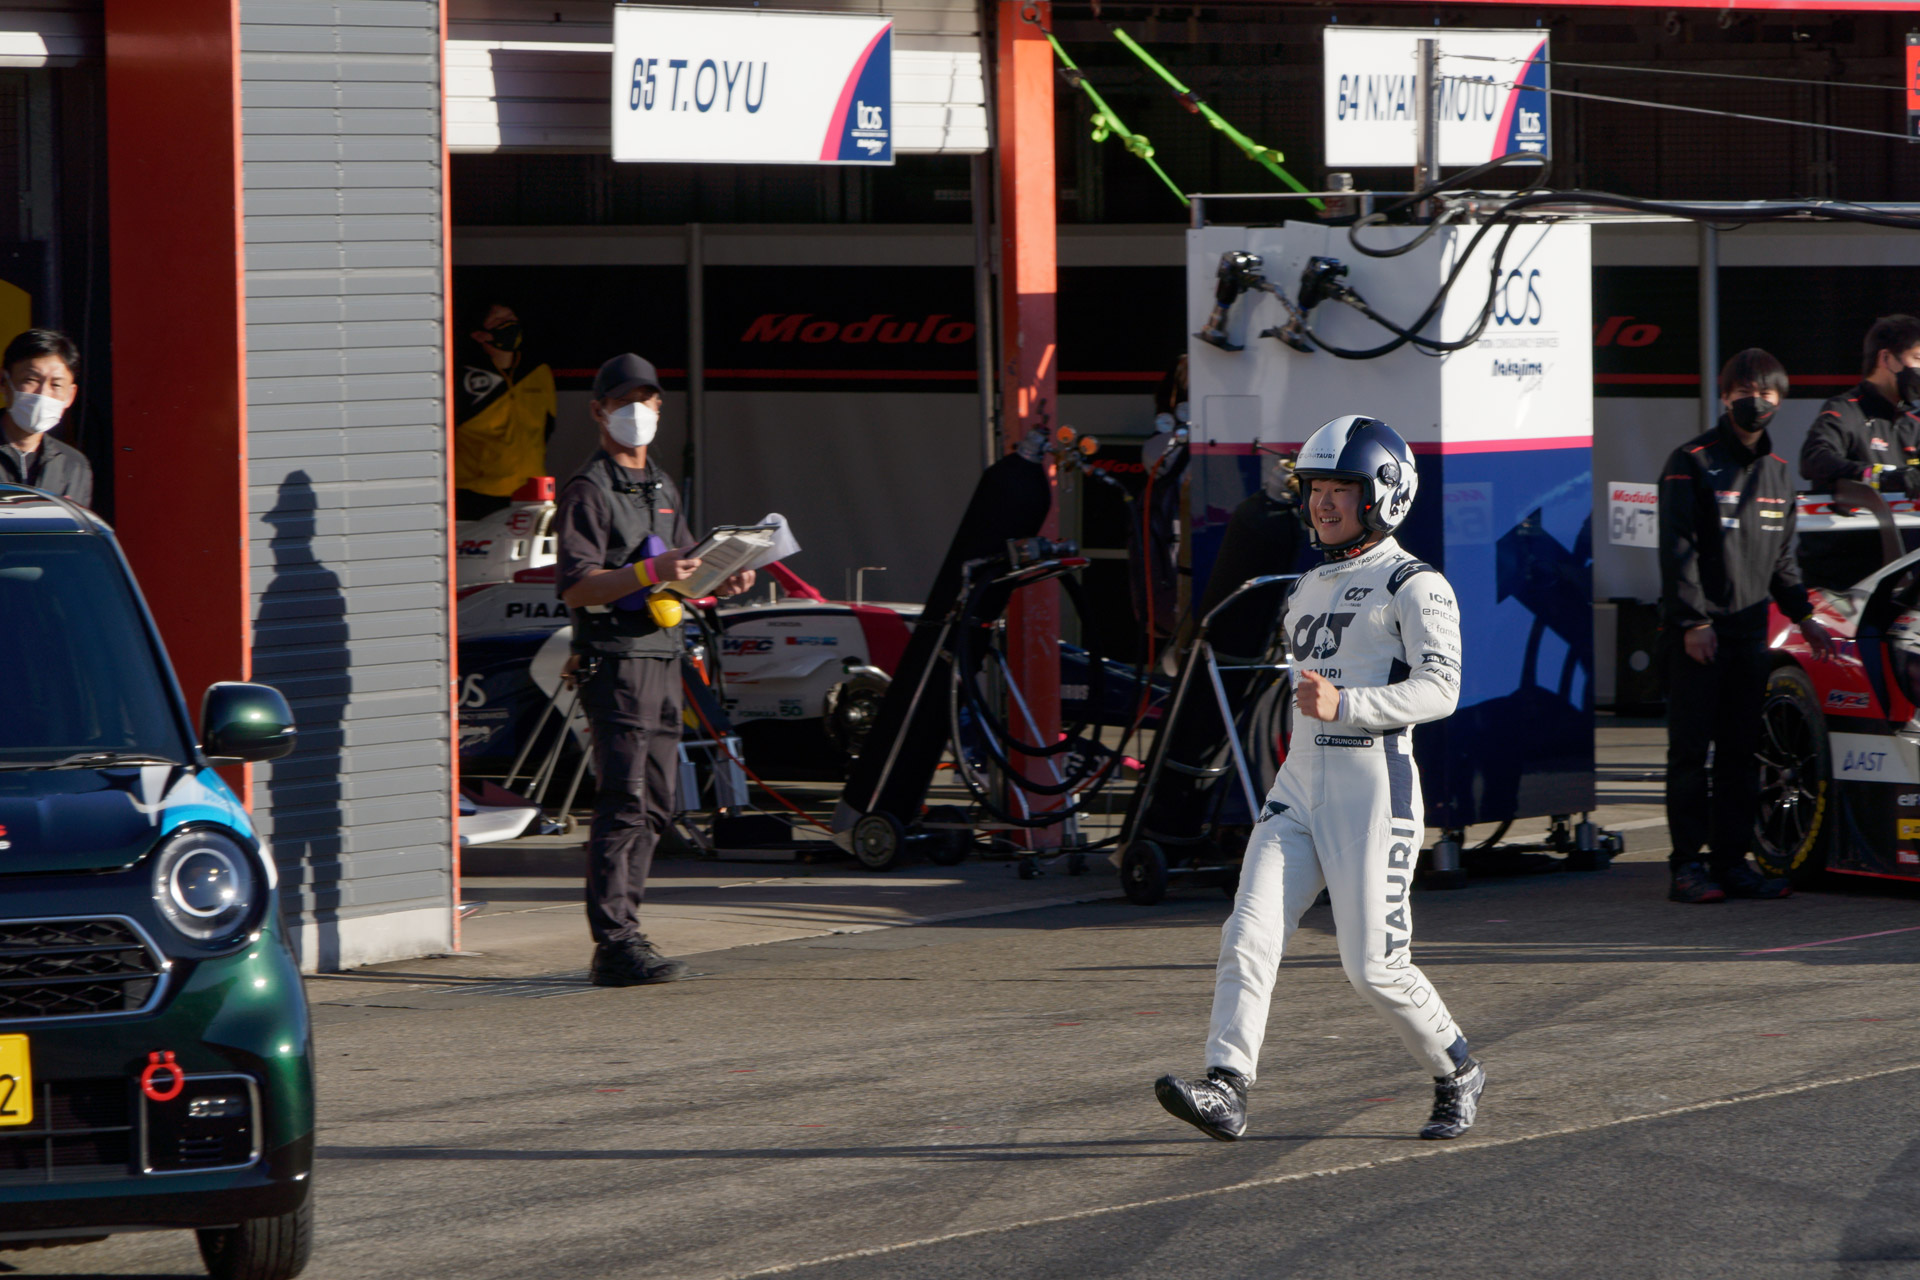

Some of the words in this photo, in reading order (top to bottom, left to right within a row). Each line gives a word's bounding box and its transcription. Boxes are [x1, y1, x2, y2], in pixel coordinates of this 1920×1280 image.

[630, 58, 658, 111] 65
[669, 59, 767, 113] T.OYU
[1338, 74, 1359, 120] 64
[740, 313, 976, 343] Modulo
[1611, 489, 1659, 504] Modulo
[506, 602, 570, 618] PIAA
[1331, 737, 1362, 746] TSUNODA
